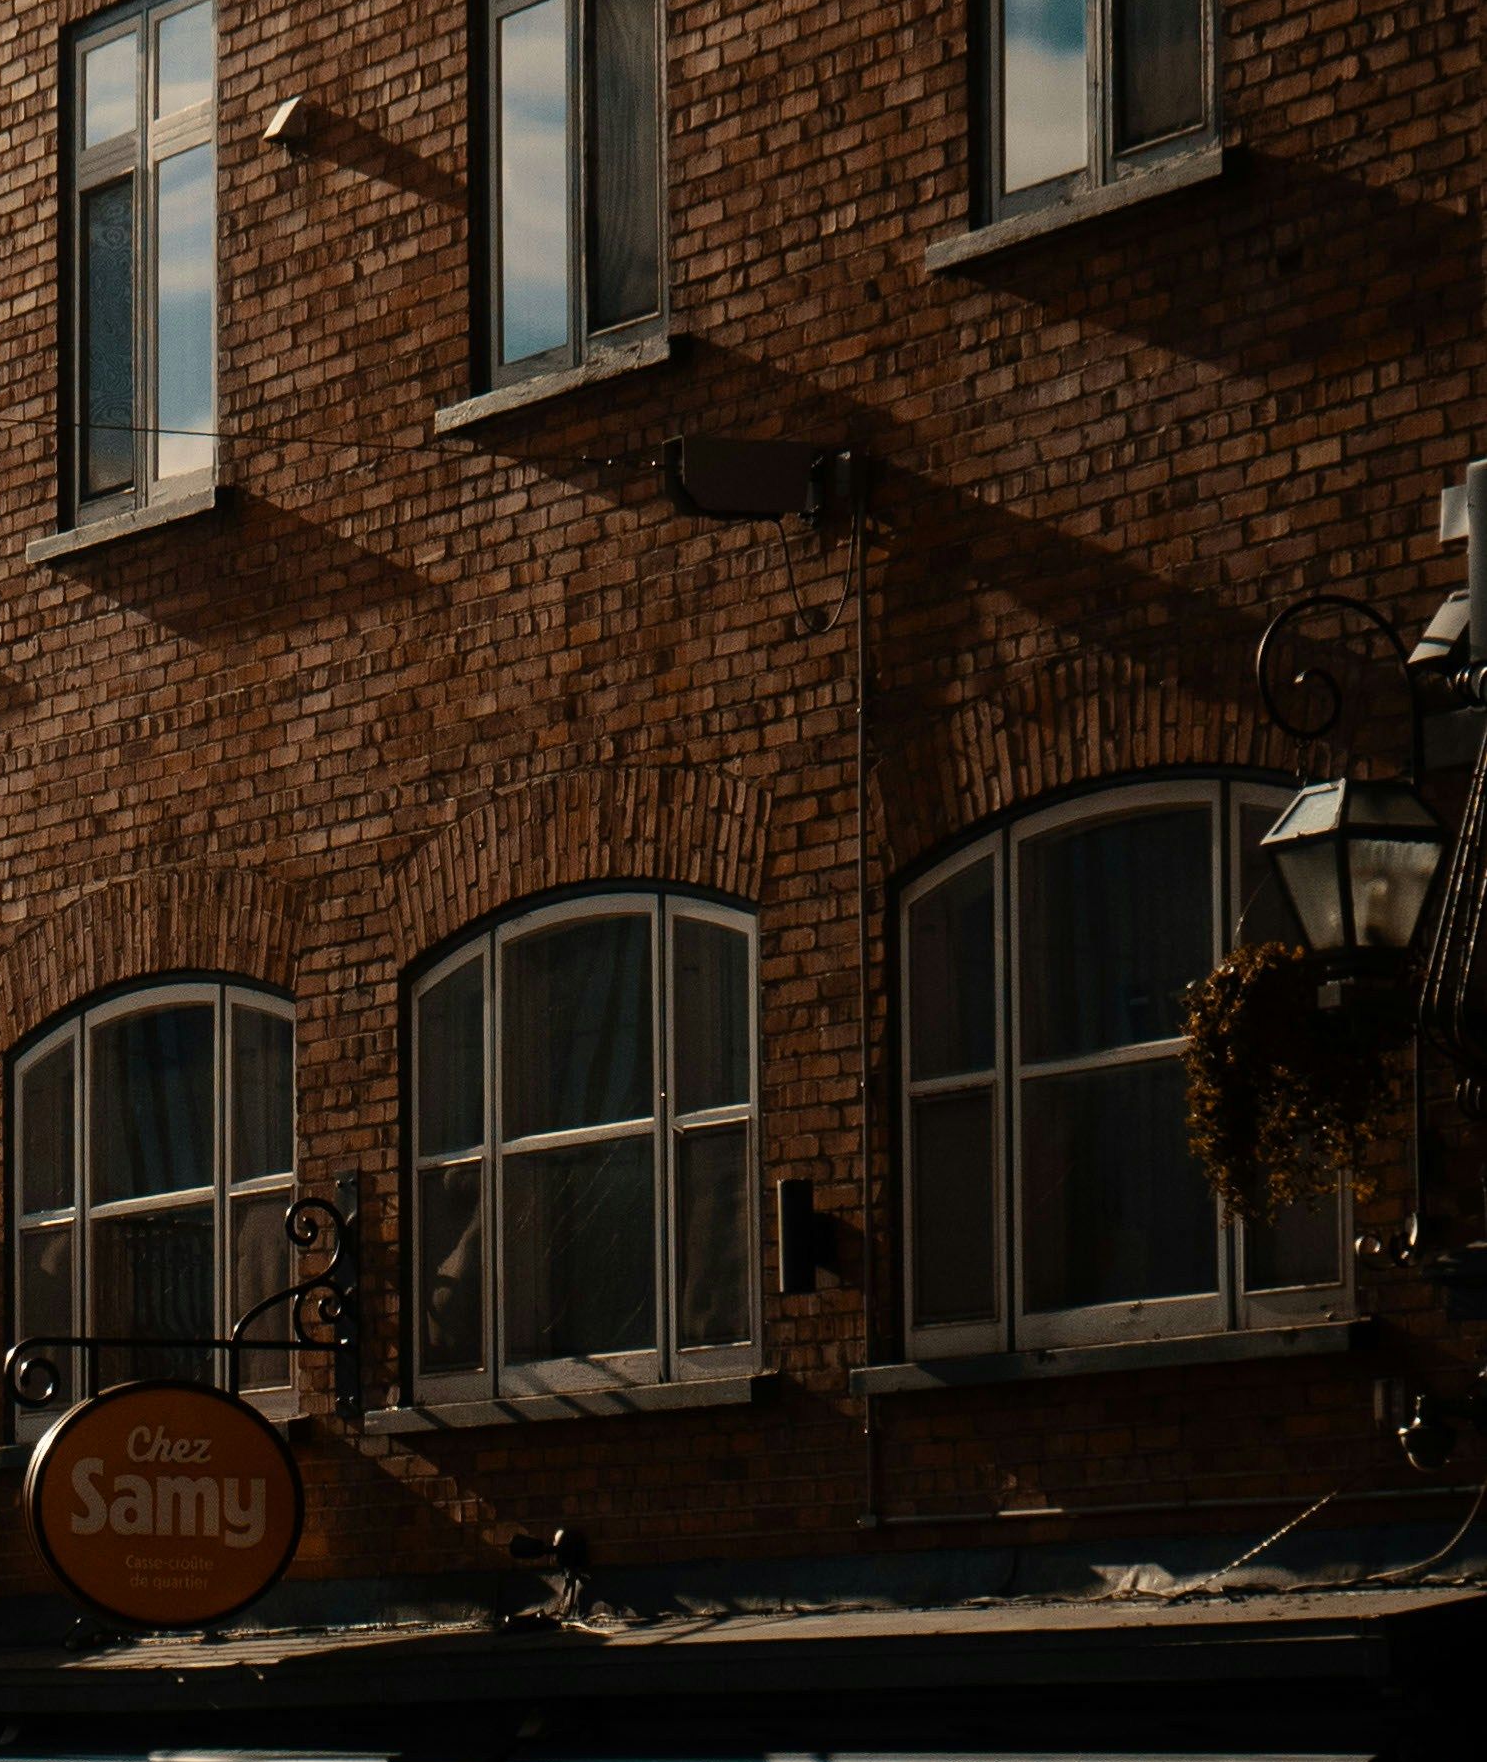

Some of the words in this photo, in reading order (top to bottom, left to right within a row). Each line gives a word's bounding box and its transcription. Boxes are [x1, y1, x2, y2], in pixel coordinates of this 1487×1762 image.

[126, 1425, 212, 1463] Chez
[70, 1456, 266, 1550] Samy
[125, 1554, 214, 1571] Casse-croûte
[129, 1573, 148, 1589] de
[153, 1574, 209, 1591] quartier
